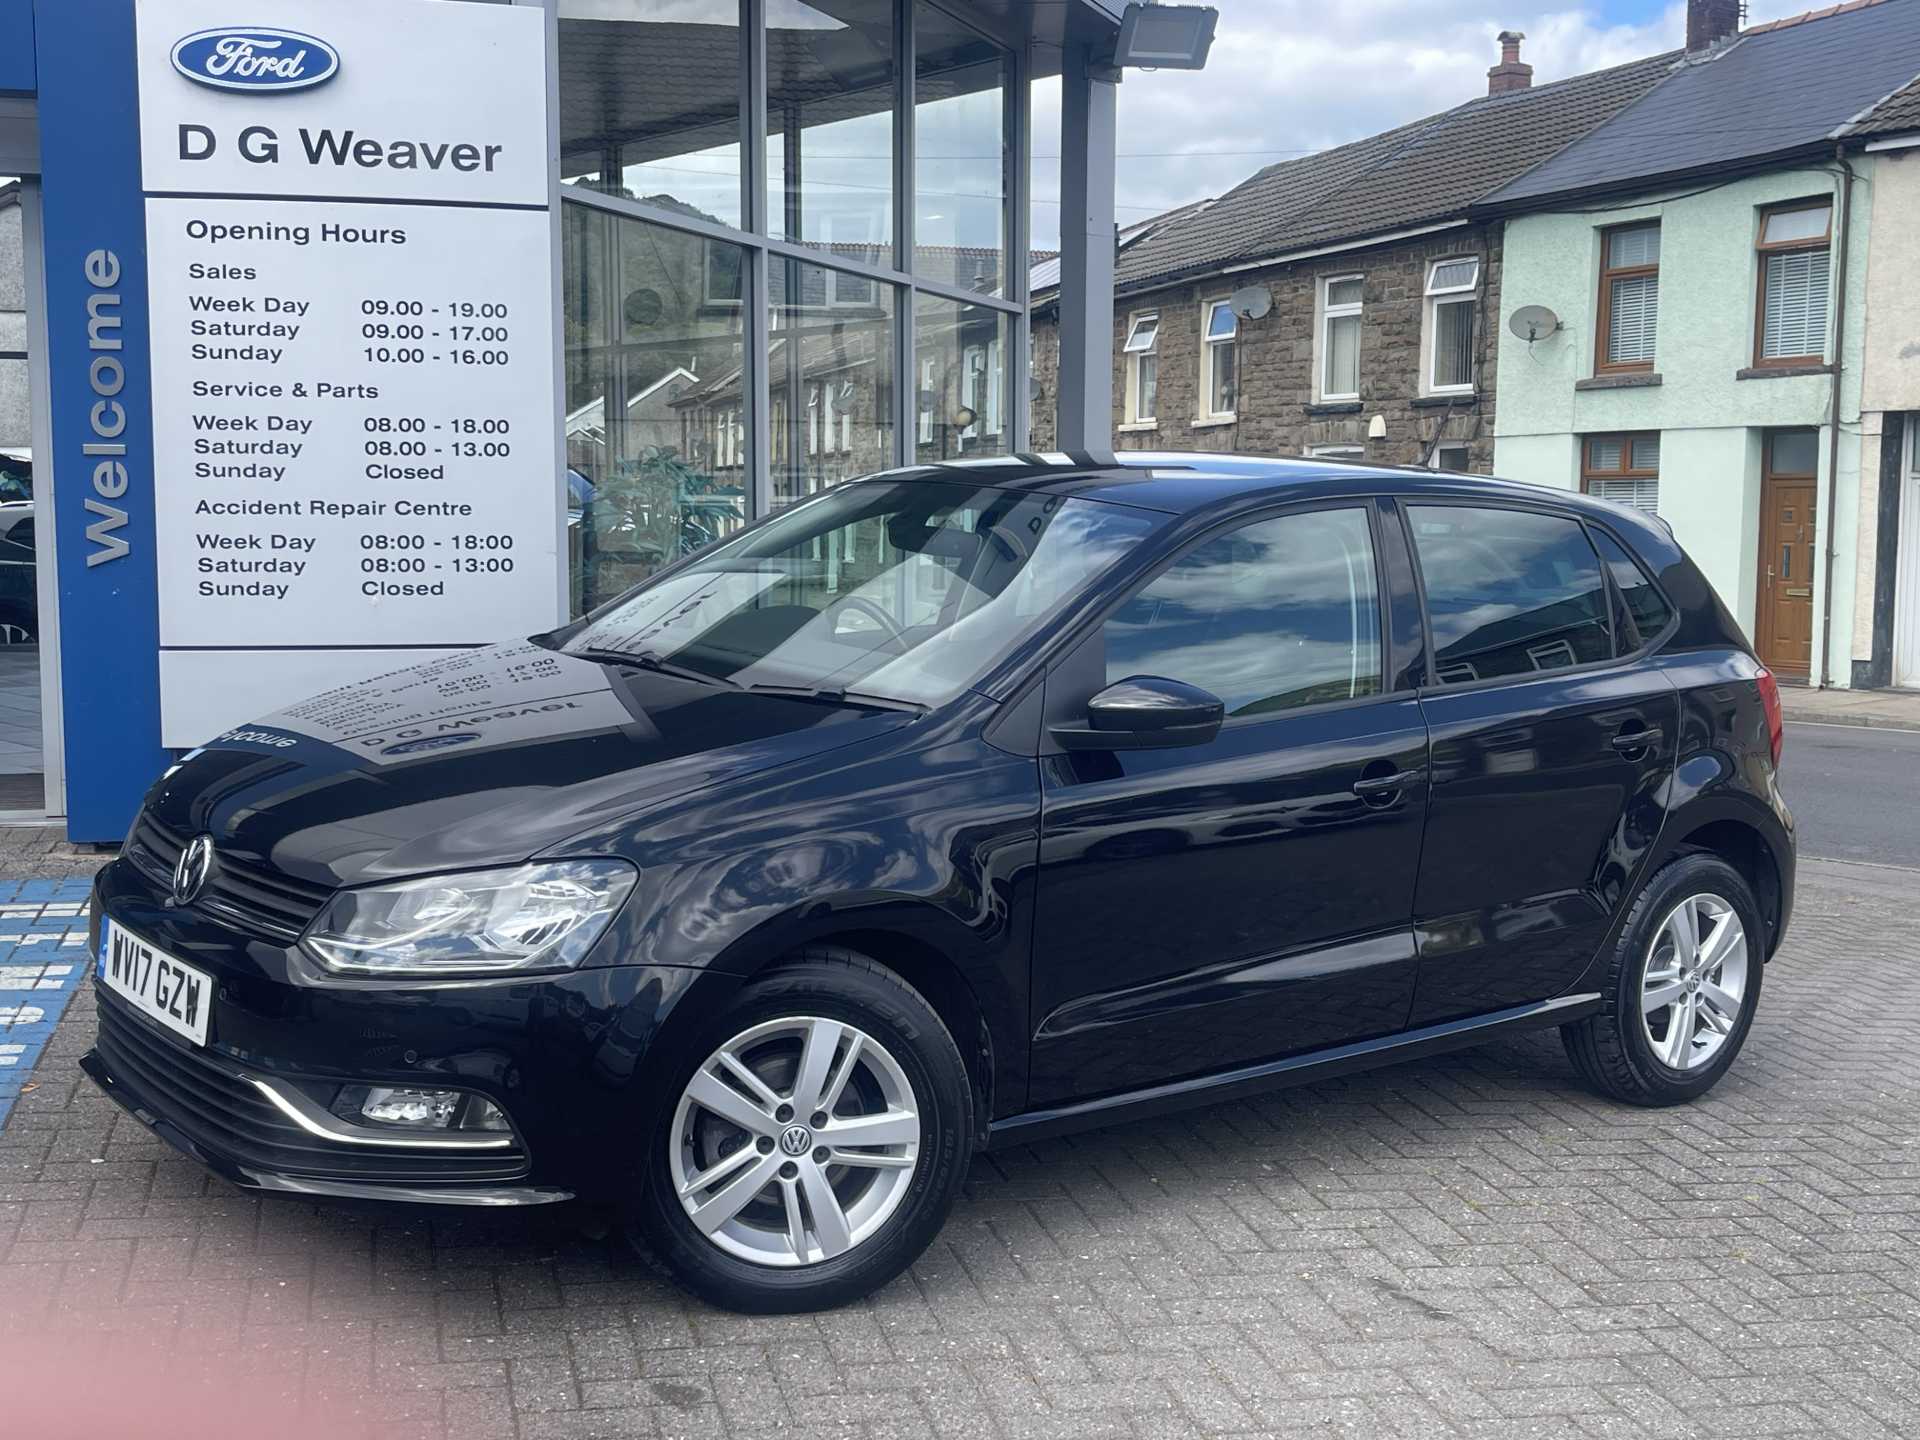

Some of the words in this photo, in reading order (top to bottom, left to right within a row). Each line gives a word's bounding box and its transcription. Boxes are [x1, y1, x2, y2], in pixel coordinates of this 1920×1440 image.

[206, 37, 307, 78] Ford
[178, 123, 217, 161] D
[237, 125, 279, 164] G
[297, 127, 503, 173] Weaver
[185, 219, 310, 246] Opening
[321, 223, 407, 245] Hours
[188, 262, 257, 281] Sales
[188, 295, 256, 313] Week
[264, 296, 311, 318] Day
[361, 299, 424, 317] 09.00
[448, 302, 508, 319] 19.00
[190, 319, 301, 341] Saturday
[361, 323, 424, 340] 09.00
[449, 325, 509, 343] 17.00
[191, 343, 284, 365] Sunday
[363, 346, 425, 364] 10.00
[449, 349, 509, 366] 16.00
[192, 380, 283, 398] Service
[291, 382, 309, 398] &
[316, 382, 379, 399] Parts
[84, 248, 130, 568] Welcome
[191, 414, 259, 432] Week
[267, 415, 313, 435] Day
[363, 417, 426, 433] 08.00
[450, 418, 510, 435] 18.00
[193, 438, 304, 459] Saturday
[364, 440, 427, 457] 08.00
[451, 441, 511, 458] 13.00
[194, 462, 287, 483] Sunday
[365, 463, 444, 480] Closed
[194, 499, 302, 516] Accident
[309, 499, 388, 520] Repair
[394, 500, 473, 517] Centre
[195, 533, 263, 550] Week
[270, 534, 317, 553] Day
[359, 534, 425, 550] 08:00
[451, 534, 514, 550] 18:00
[197, 556, 307, 577] Saturday
[360, 557, 426, 574] 08:00
[451, 557, 514, 573] 13:00
[198, 580, 290, 600] Sunday
[361, 580, 444, 597] Closed
[112, 928, 154, 997] WV17
[155, 959, 201, 1028] GZW
